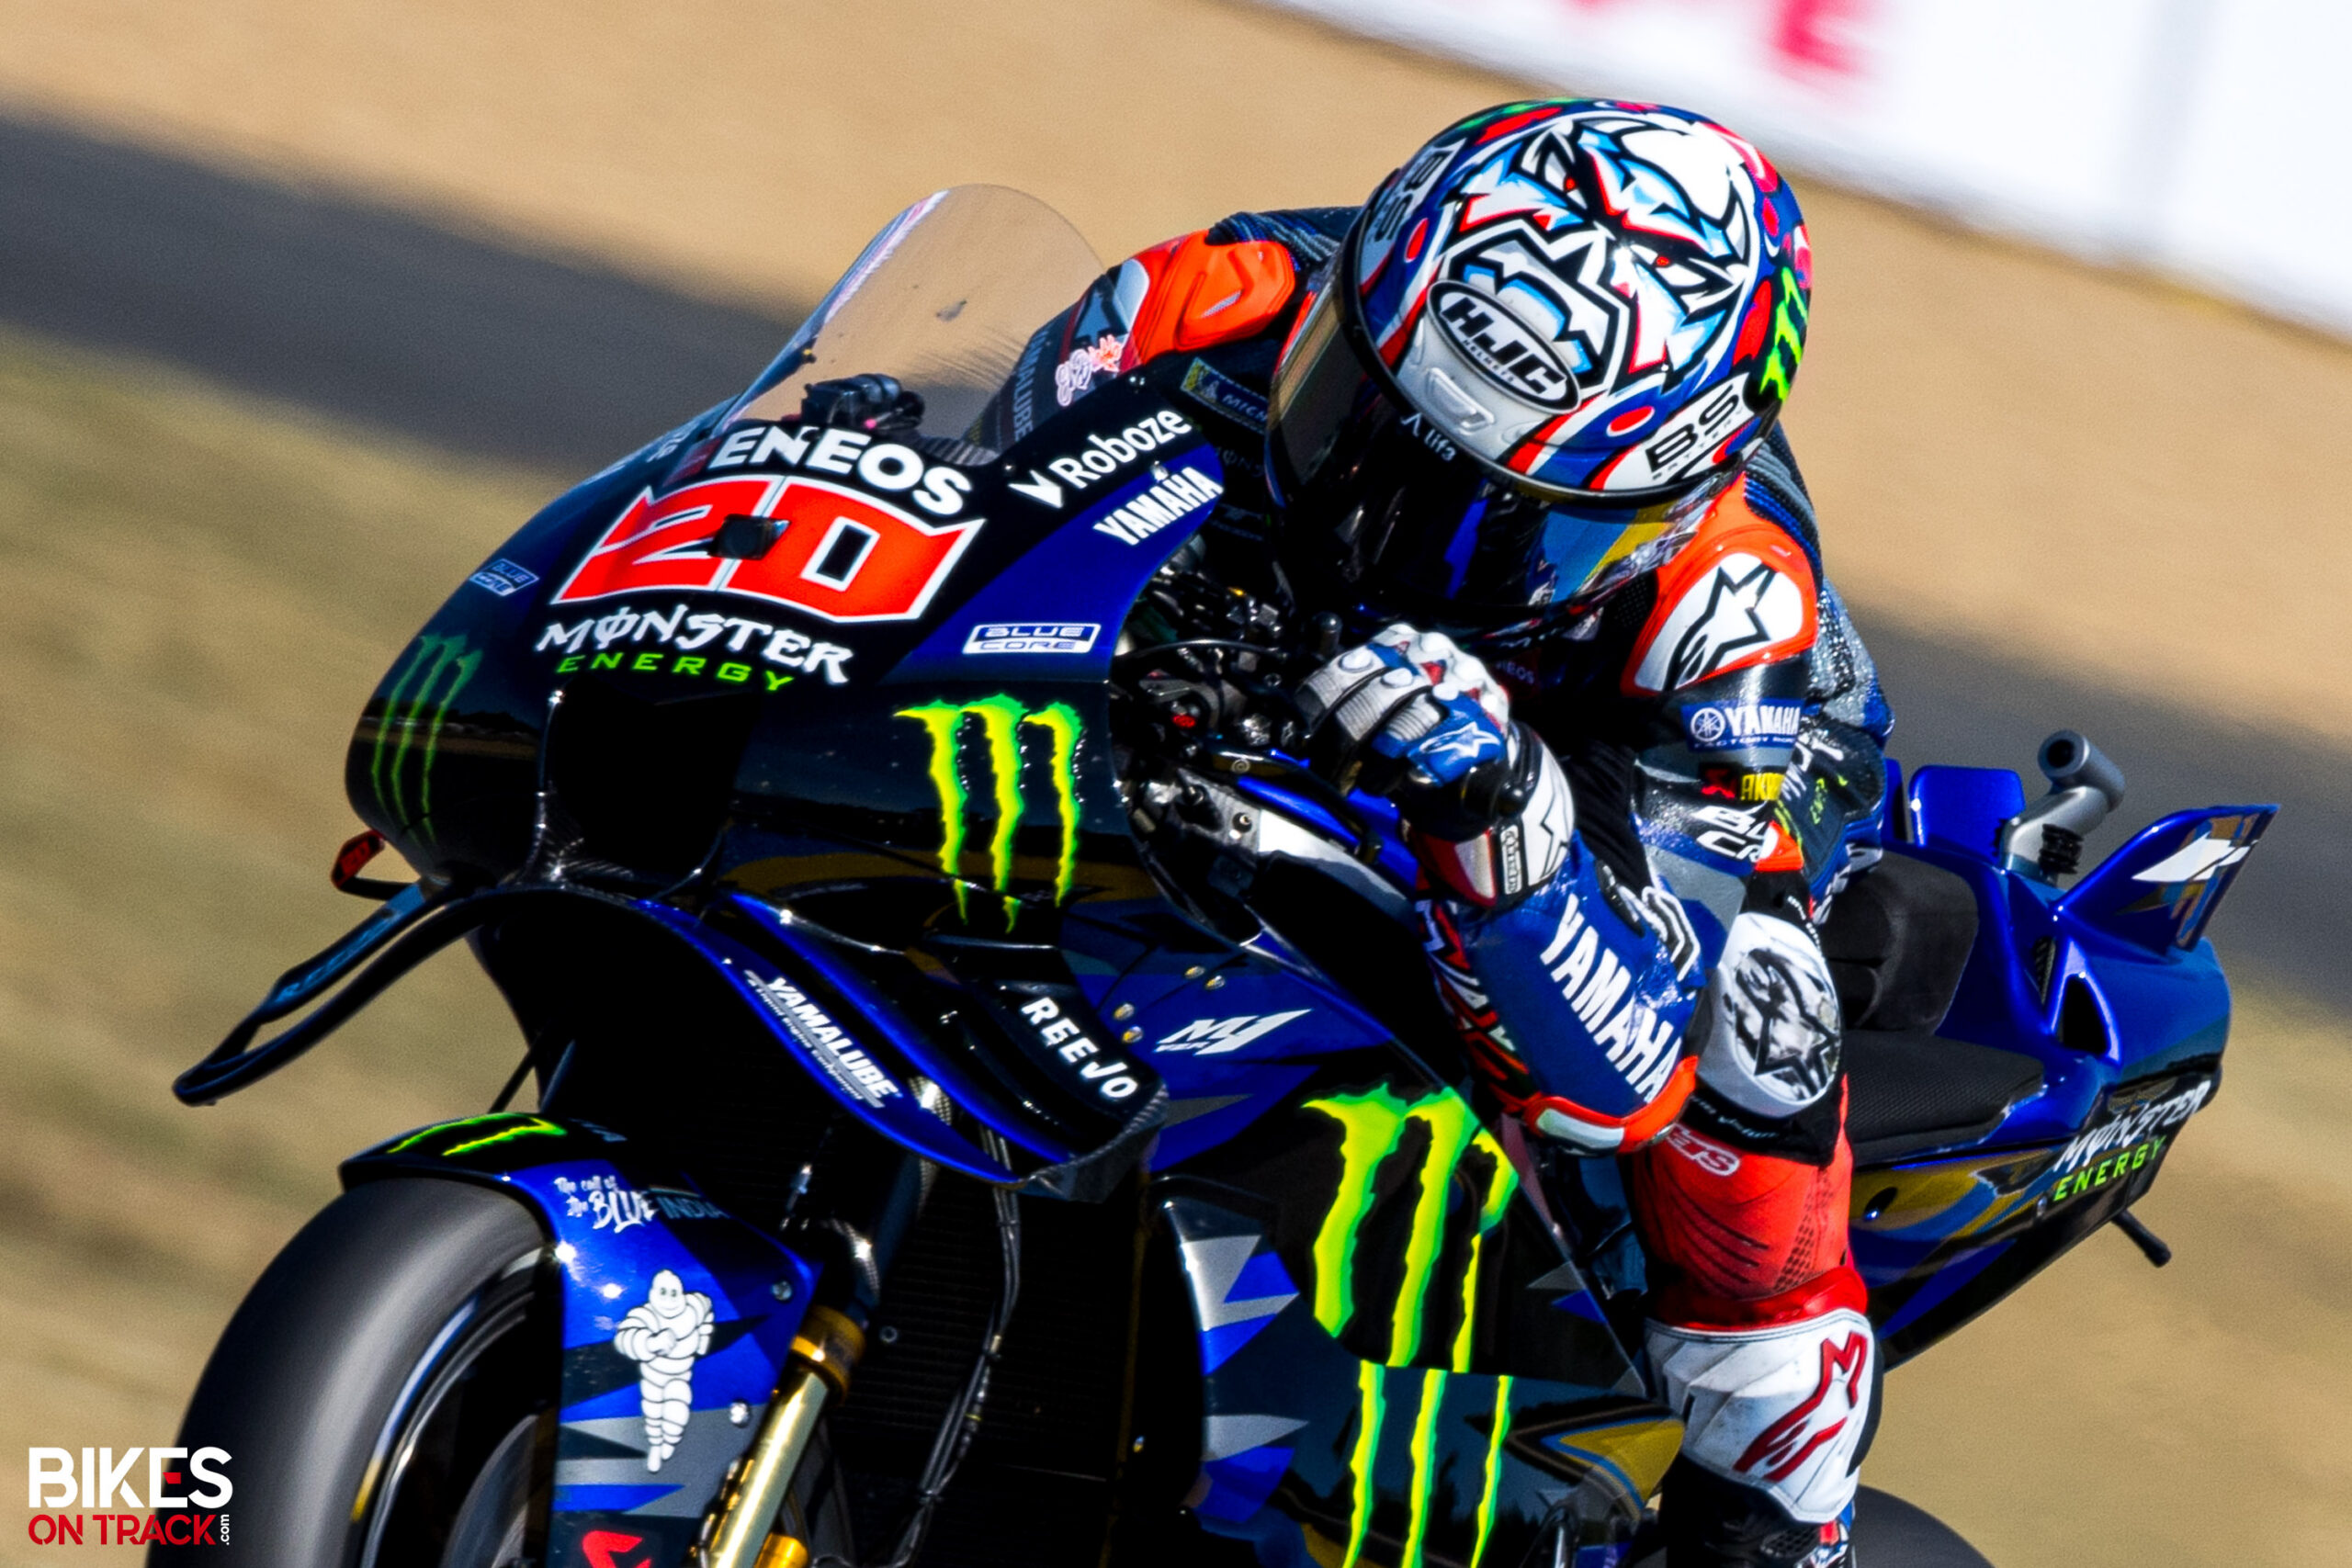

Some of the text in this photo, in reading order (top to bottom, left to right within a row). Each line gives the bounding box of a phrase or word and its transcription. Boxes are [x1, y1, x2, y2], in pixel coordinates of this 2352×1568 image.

[1440, 297, 1566, 394] HJC
[1462, 338, 1517, 383] HELMETS
[1048, 410, 1193, 489] Roboze
[1645, 384, 1739, 473] BS
[1652, 406, 1743, 480] BATTERY
[708, 425, 972, 515] ENEOS
[1093, 467, 1224, 546] YAMAHA
[550, 475, 986, 622] 20
[537, 604, 854, 684] MONSTER
[979, 641, 1076, 649] CORE
[984, 626, 1085, 637] BLUE
[557, 652, 796, 693] ENERGY
[1724, 706, 1801, 736] YAMAHA
[767, 976, 899, 1099] YAMALUBE
[1540, 894, 1682, 1103] YAMAHA
[1022, 997, 1137, 1100] REEJO
[2053, 1135, 2166, 1201] ENERGY
[588, 1190, 659, 1234] BLUE
